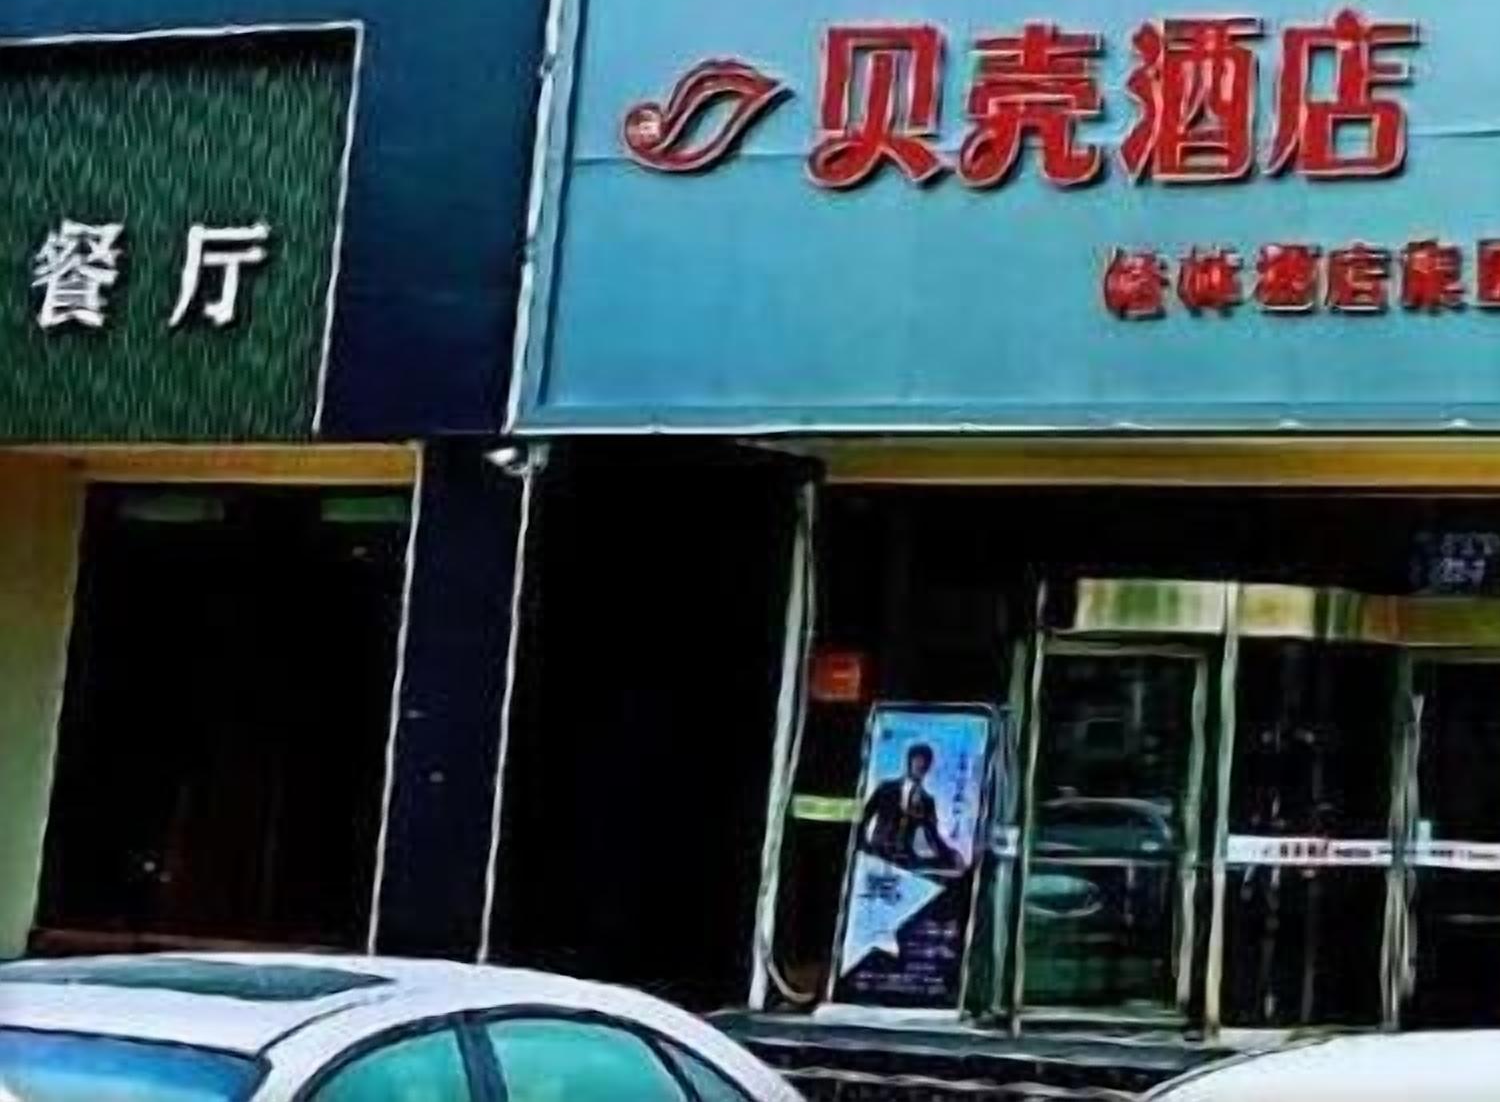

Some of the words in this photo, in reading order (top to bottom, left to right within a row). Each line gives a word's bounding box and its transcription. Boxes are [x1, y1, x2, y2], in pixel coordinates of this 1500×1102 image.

[807, 9, 1420, 189] 贝壳酒店
[31, 219, 271, 328] 餐厅
